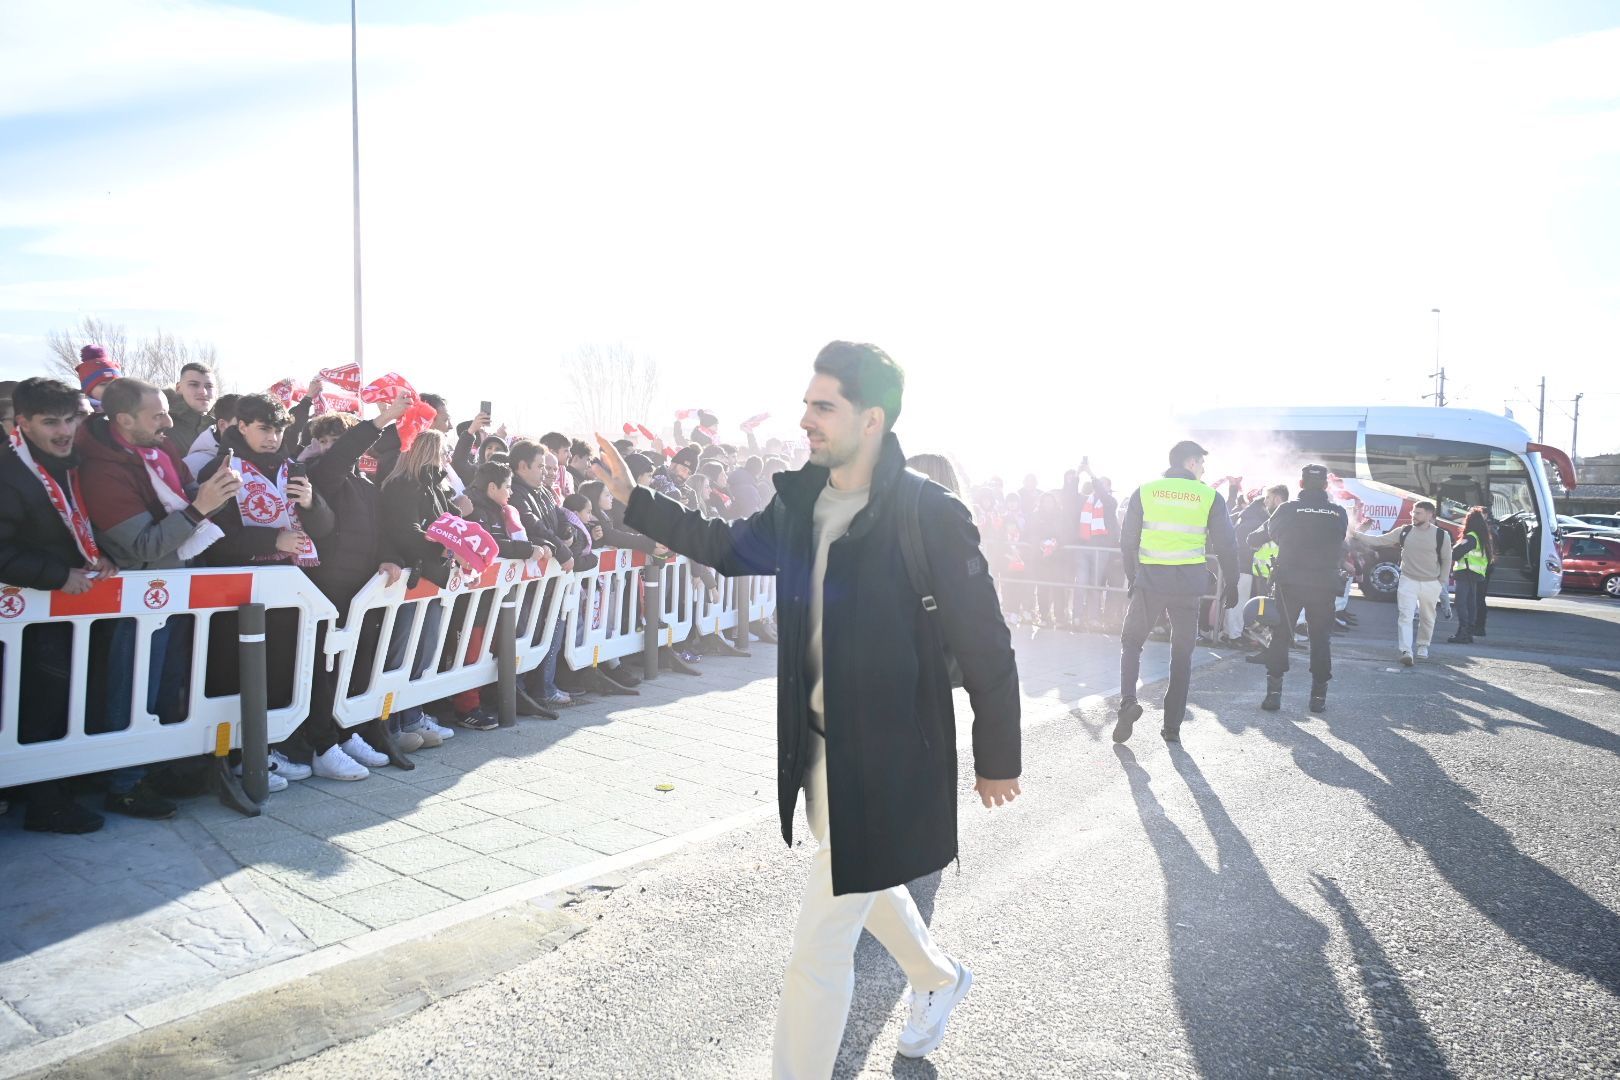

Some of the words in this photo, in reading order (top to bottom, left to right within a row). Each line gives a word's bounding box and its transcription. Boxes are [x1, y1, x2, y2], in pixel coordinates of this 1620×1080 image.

[1152, 490, 1201, 502] VISEGURSA
[1297, 508, 1336, 516] POLICIA
[1364, 505, 1398, 517] PORTIVA
